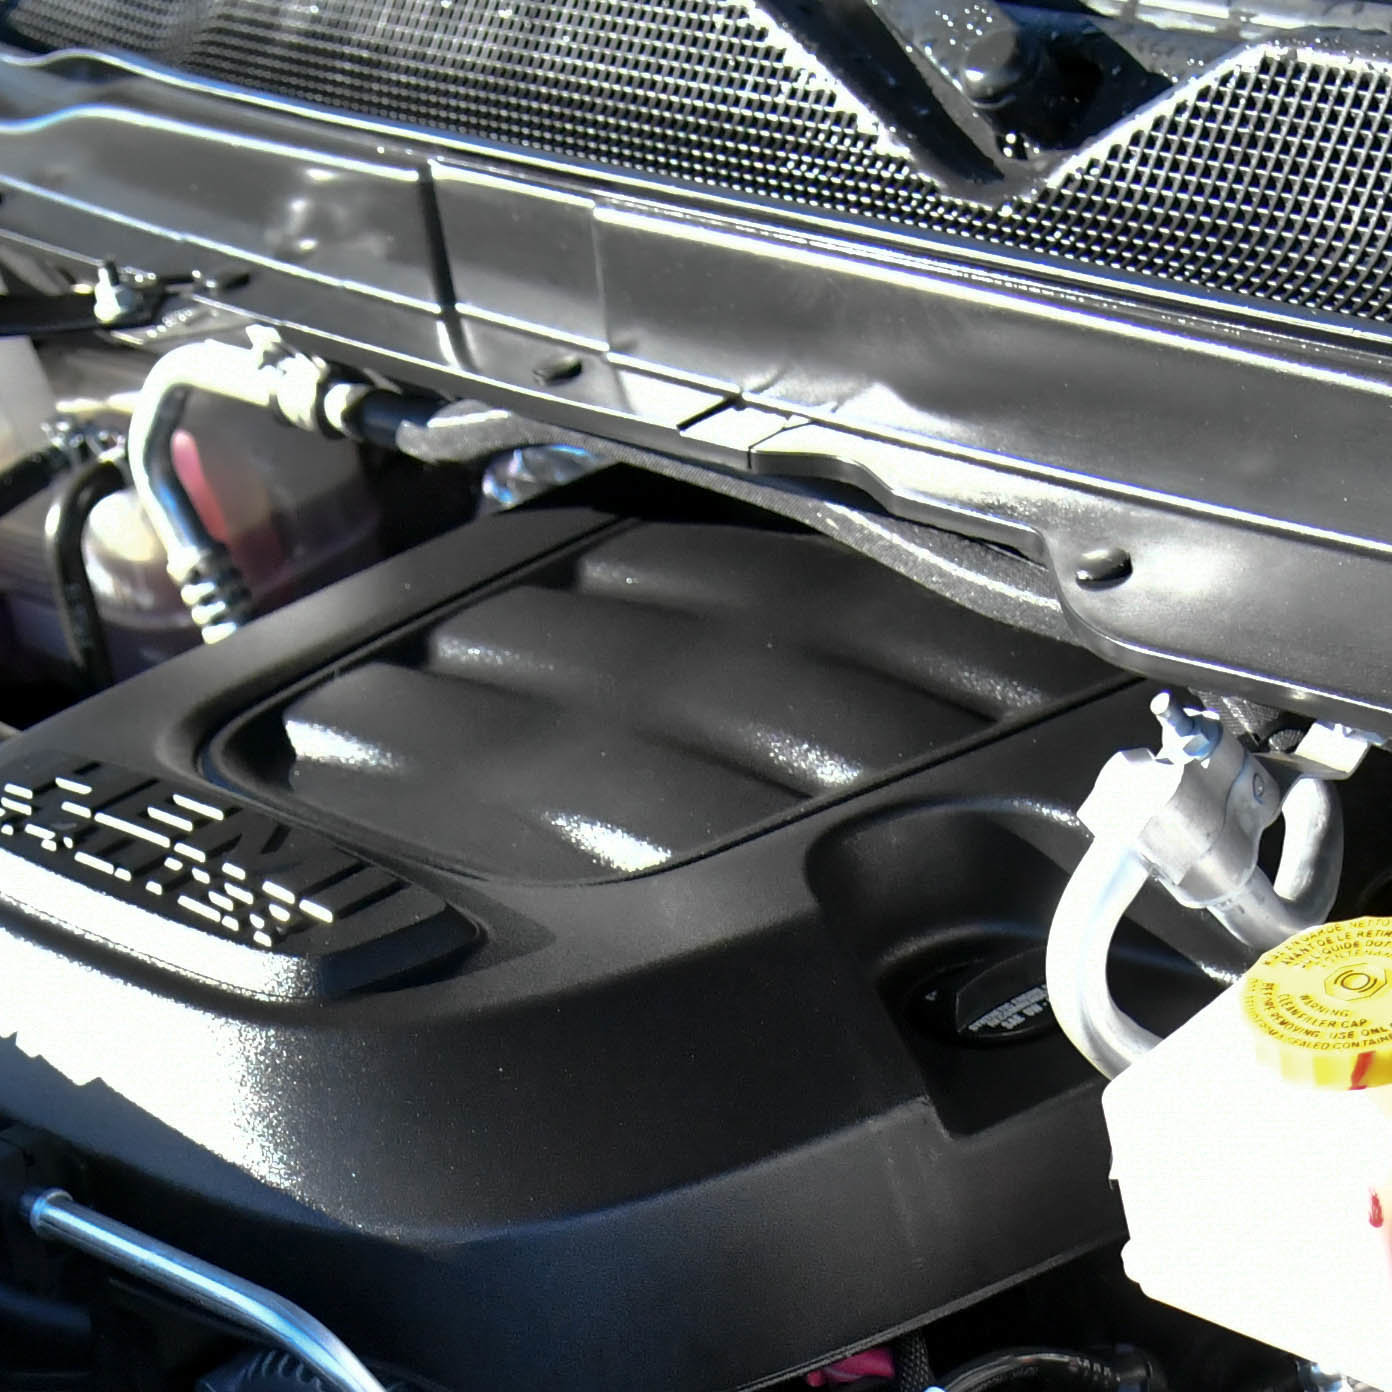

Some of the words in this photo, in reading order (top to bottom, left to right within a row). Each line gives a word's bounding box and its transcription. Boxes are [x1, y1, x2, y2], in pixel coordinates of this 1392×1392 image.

[2, 755, 413, 924] HEMI
[1337, 932, 1352, 943] LE
[1340, 1018, 1369, 1029] CAP
[1329, 1028, 1356, 1040] USE
